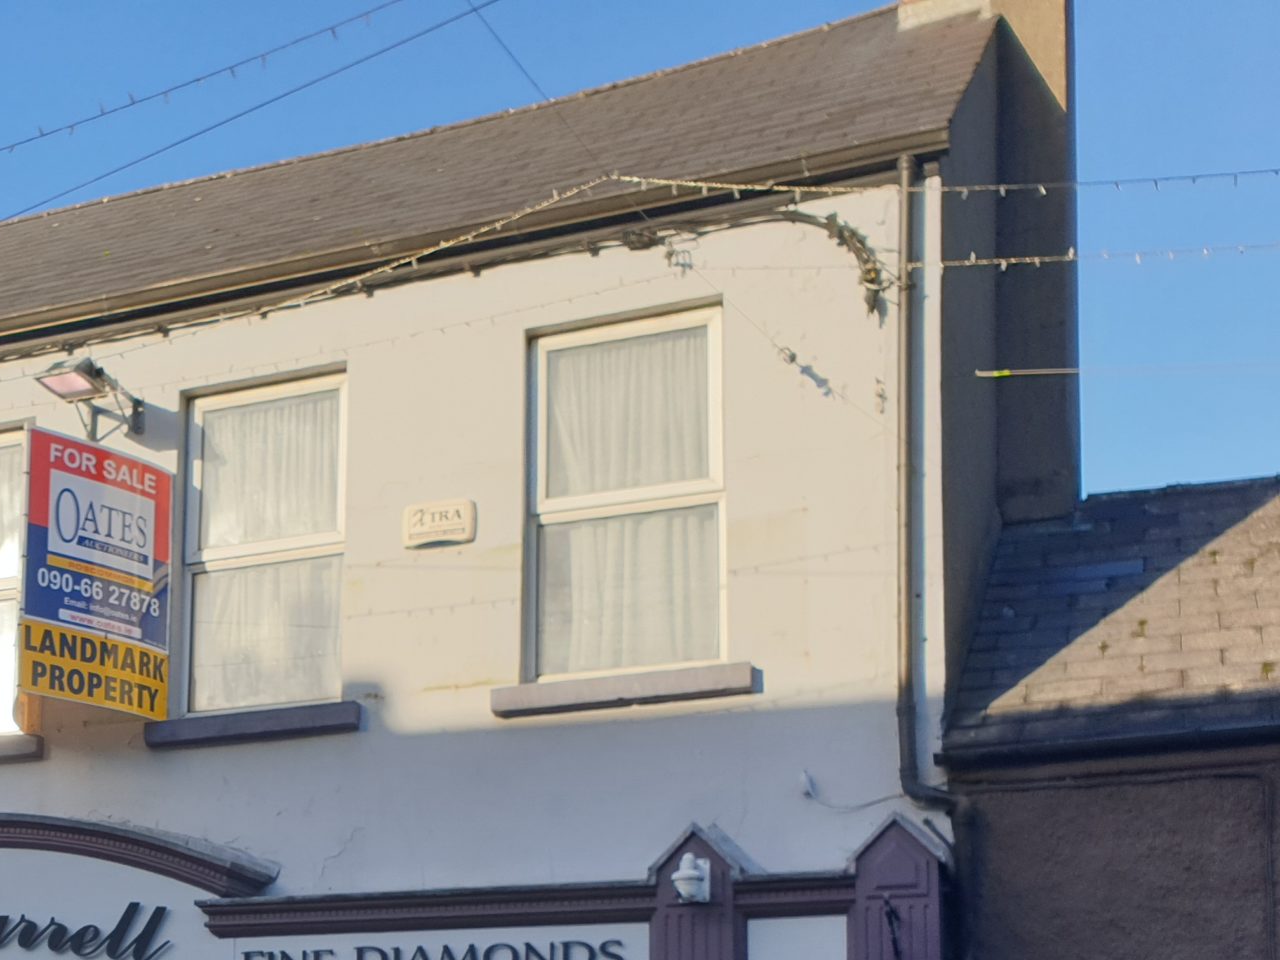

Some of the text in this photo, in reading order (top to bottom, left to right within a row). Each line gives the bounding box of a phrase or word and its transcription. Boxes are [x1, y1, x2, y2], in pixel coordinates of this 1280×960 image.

[49, 442, 158, 495] FOR SALE
[55, 487, 148, 550] OATES
[37, 567, 160, 617] 090-66 27878
[24, 624, 164, 683] LANDMARK
[31, 660, 158, 712] PROPERTY
